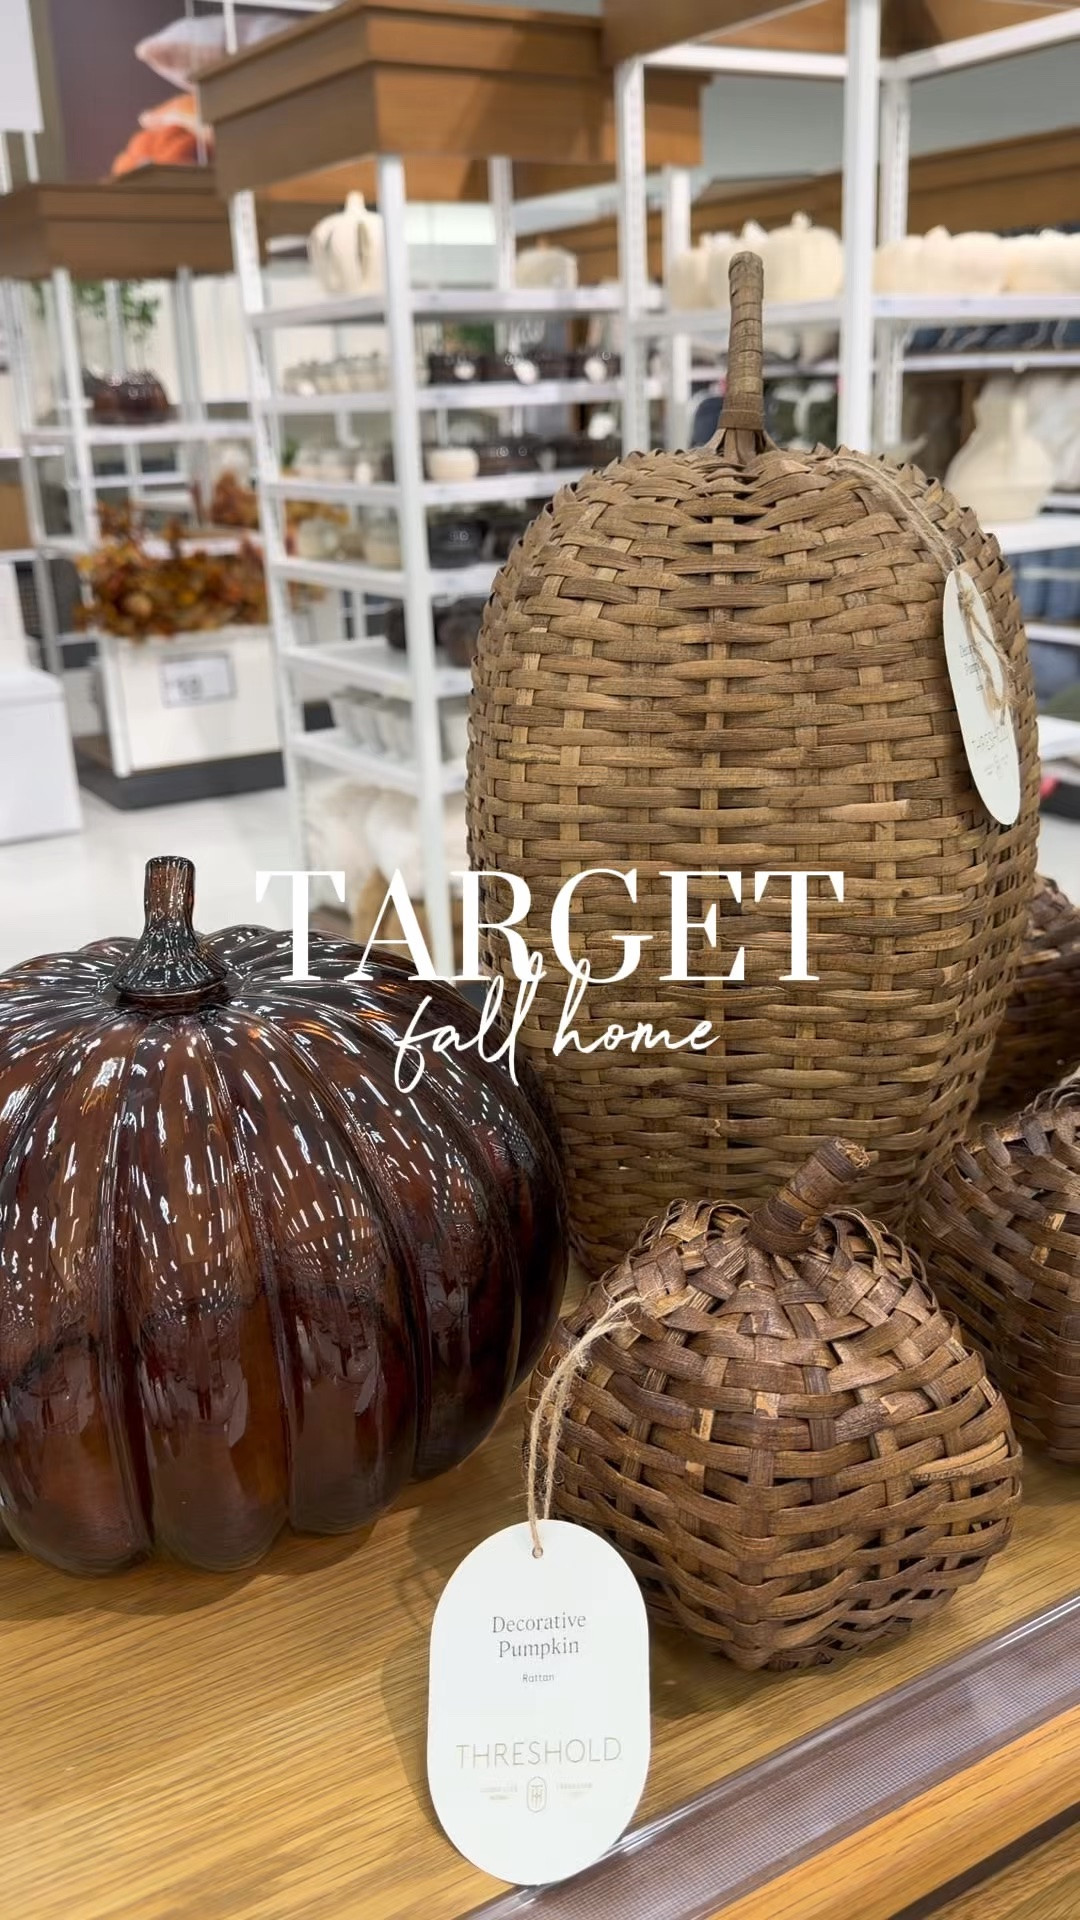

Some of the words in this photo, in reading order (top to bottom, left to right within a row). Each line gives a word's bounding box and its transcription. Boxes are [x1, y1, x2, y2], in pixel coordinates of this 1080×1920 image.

[492, 1611, 587, 1634] Decorative
[499, 1637, 580, 1660] Pumpkin
[522, 1673, 555, 1683] Rattan
[455, 1736, 622, 1769] THRESHOLD
